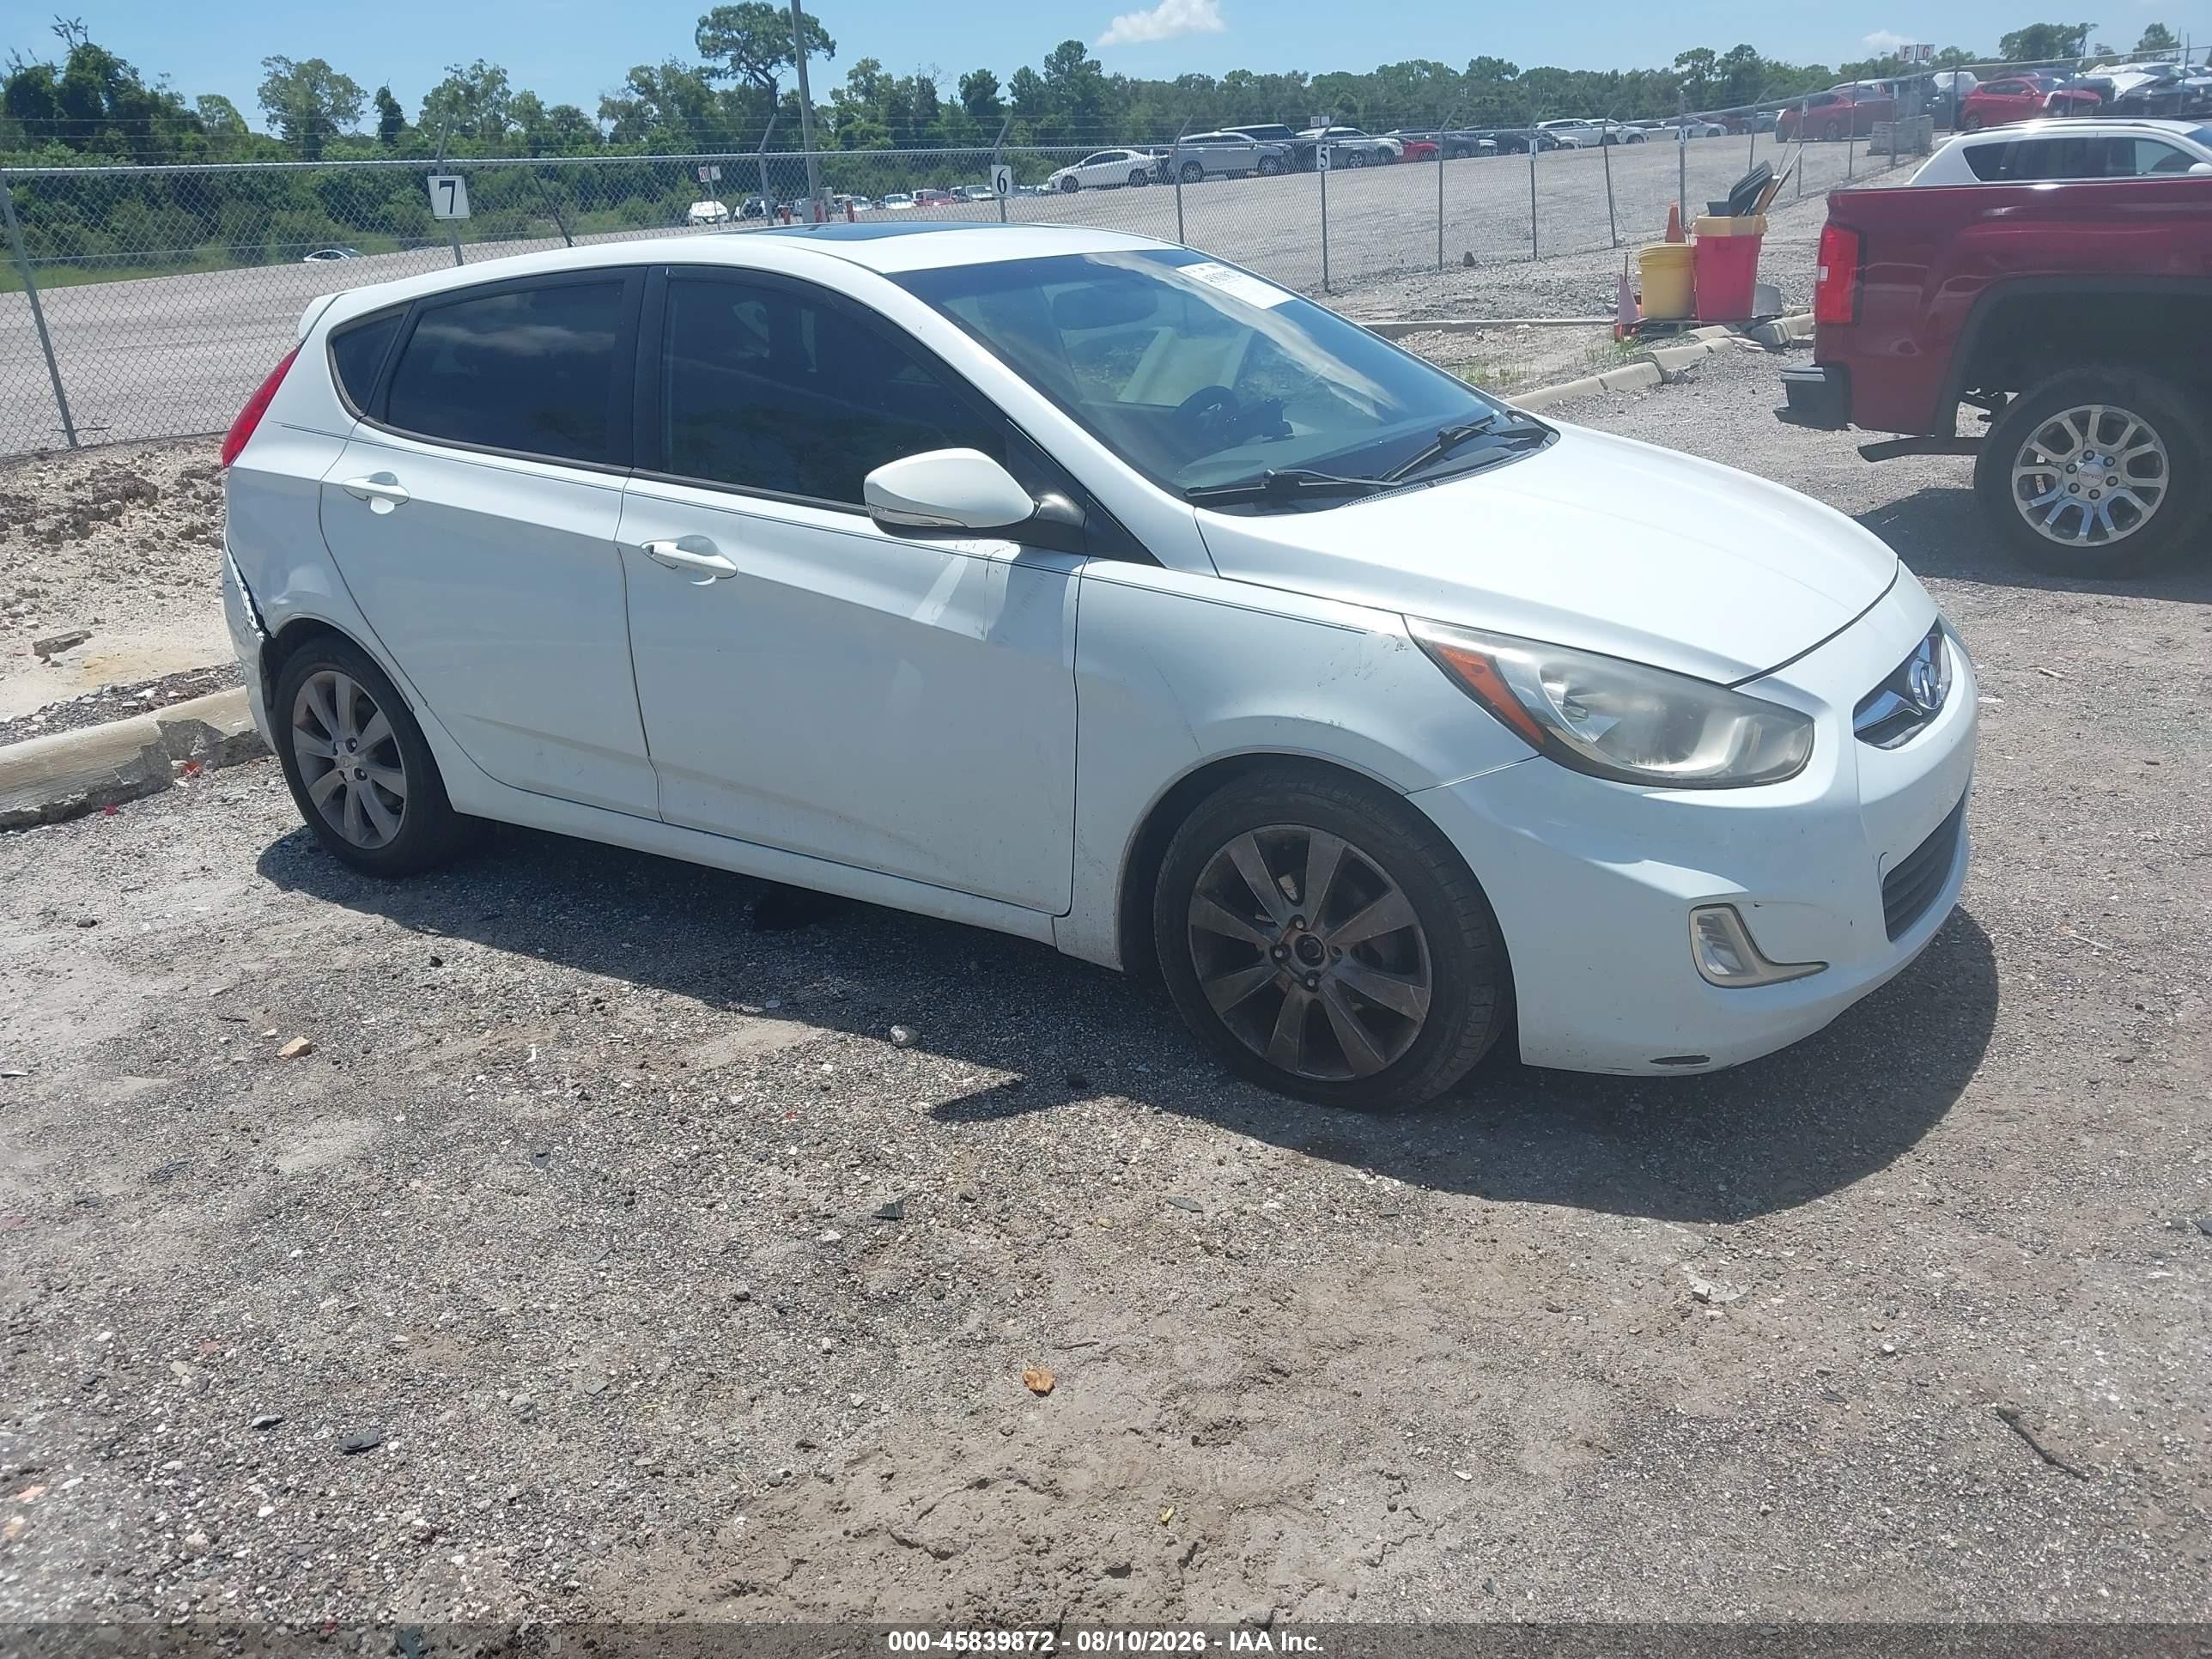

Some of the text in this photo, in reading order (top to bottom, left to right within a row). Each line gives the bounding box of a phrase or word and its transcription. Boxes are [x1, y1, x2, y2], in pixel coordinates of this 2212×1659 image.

[1904, 46, 1911, 59] F
[1923, 46, 1930, 58] G
[1320, 147, 1328, 168] 5
[996, 168, 1007, 194] 6
[438, 180, 456, 215] 7
